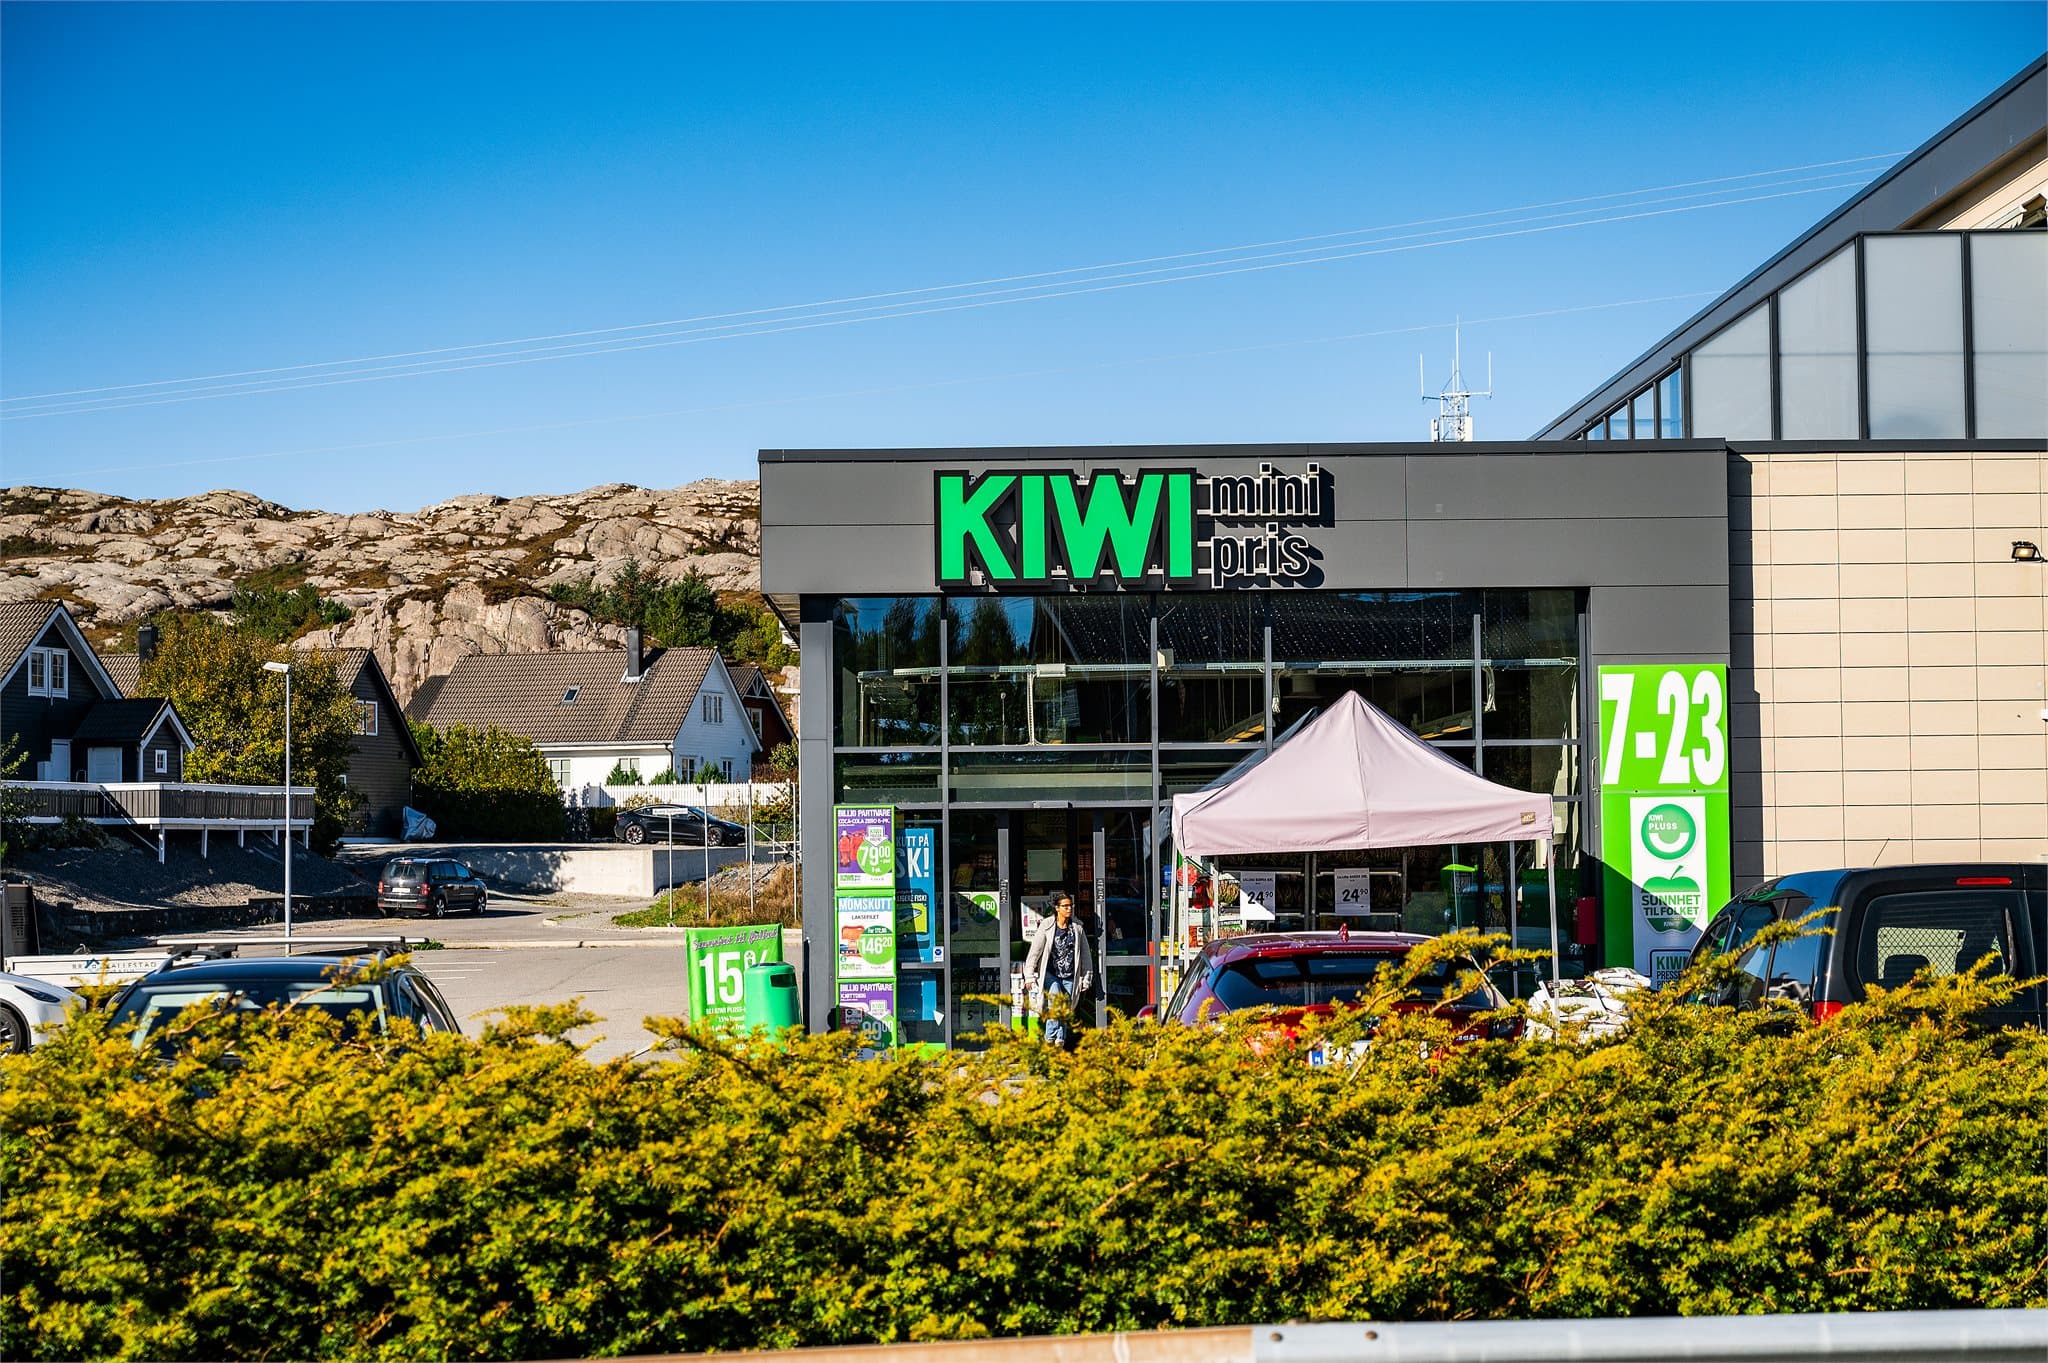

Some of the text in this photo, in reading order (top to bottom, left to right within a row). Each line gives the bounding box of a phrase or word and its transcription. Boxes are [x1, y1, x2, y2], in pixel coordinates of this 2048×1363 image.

[1210, 462, 1320, 516] mini
[938, 472, 1194, 581] KIWI
[1211, 522, 1310, 589] pris
[1601, 670, 1726, 786] 7-23
[1648, 814, 1664, 822] KIWI
[1648, 822, 1678, 831] PLUSS
[918, 833, 929, 847] PÅ
[838, 897, 891, 910] MOMSKUTT
[1641, 894, 1701, 906] SUNNHET
[1643, 906, 1700, 916] TIL FOLKET
